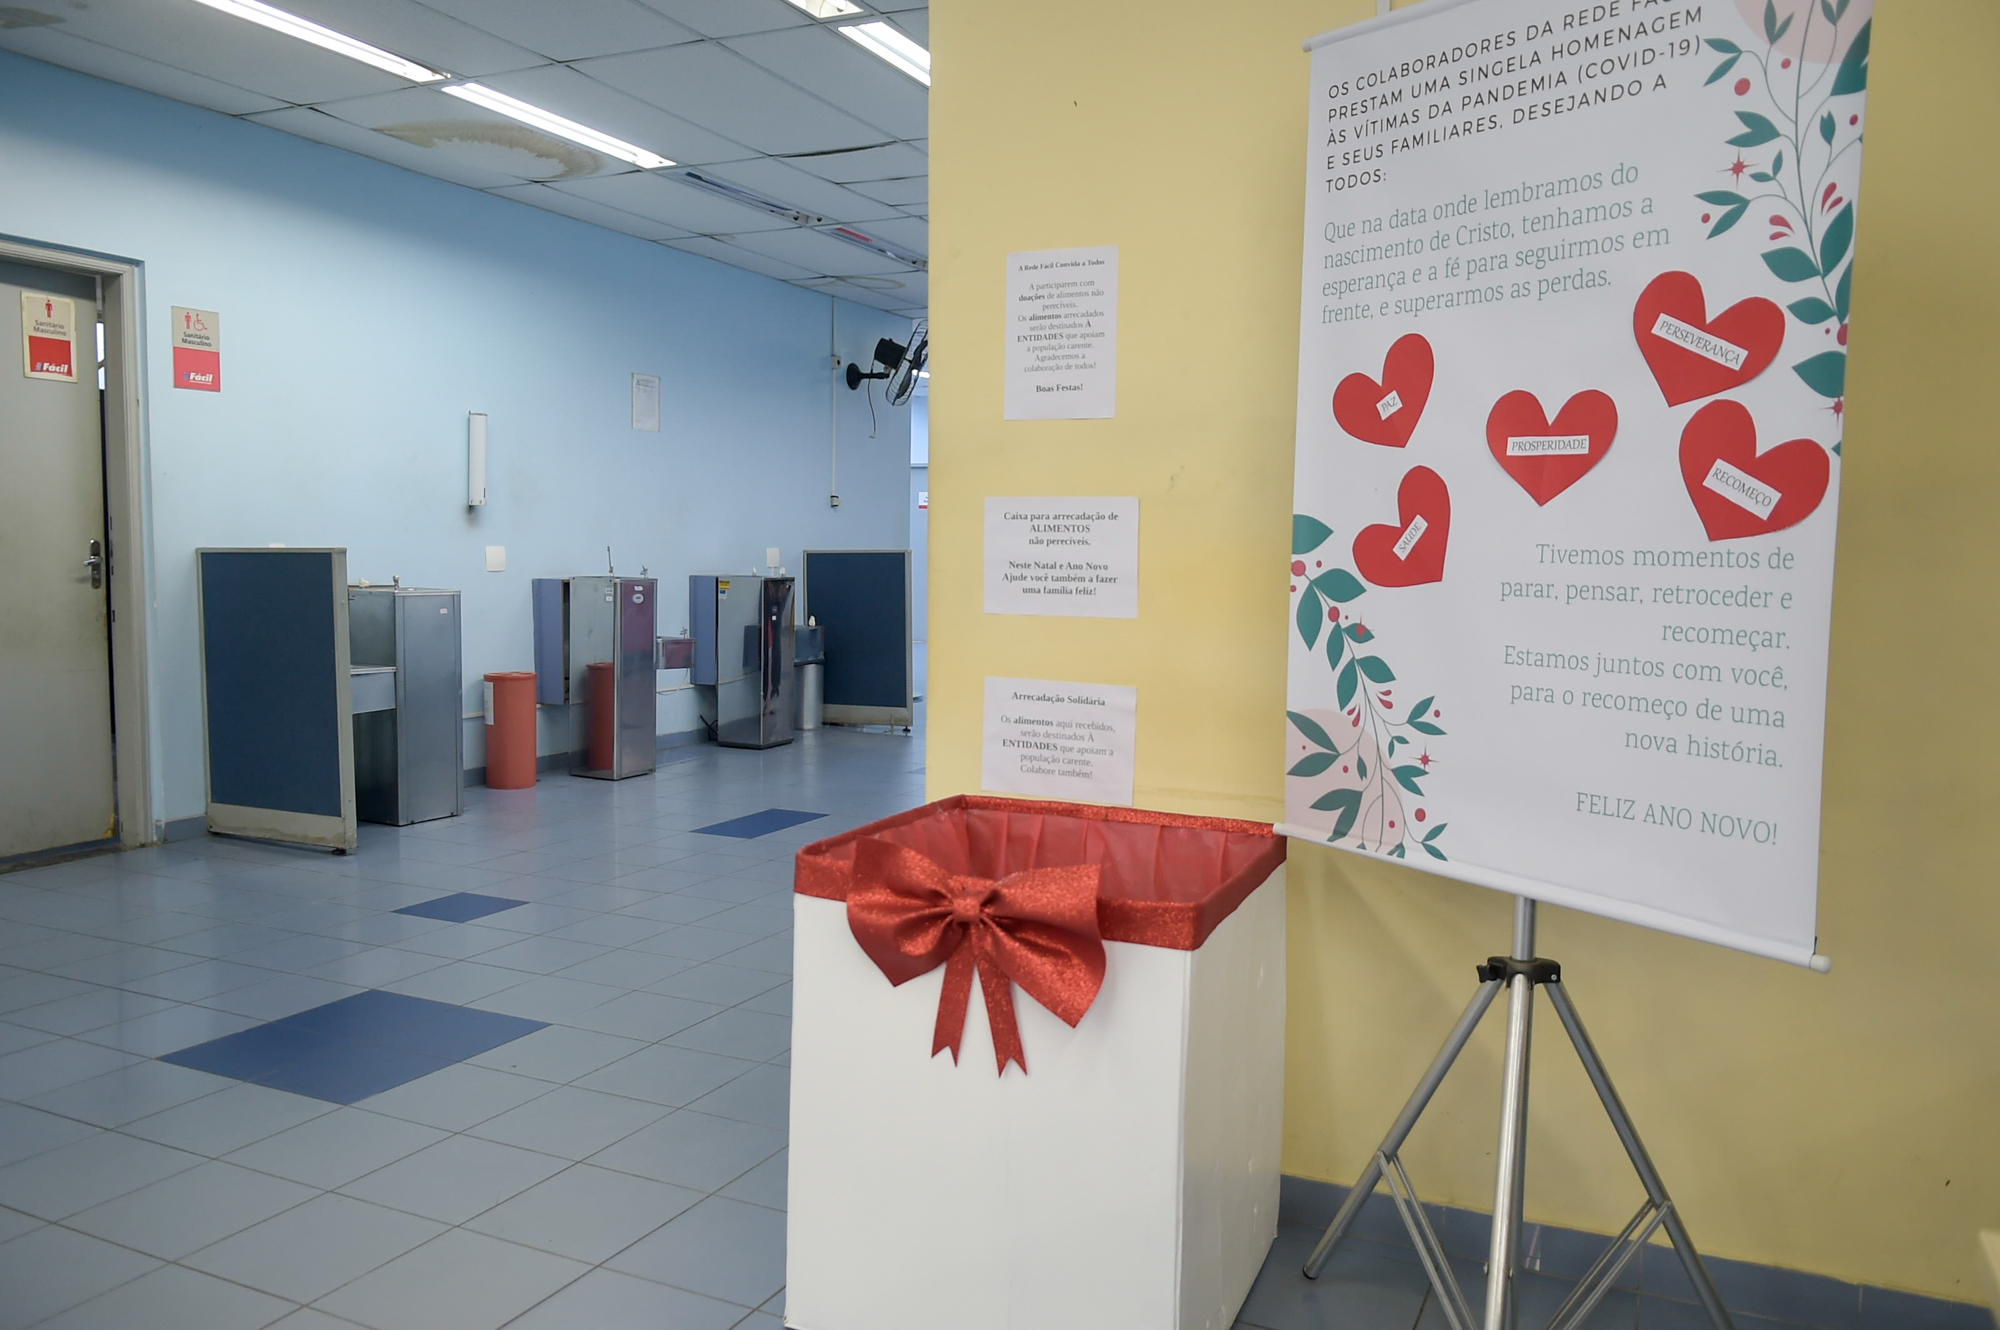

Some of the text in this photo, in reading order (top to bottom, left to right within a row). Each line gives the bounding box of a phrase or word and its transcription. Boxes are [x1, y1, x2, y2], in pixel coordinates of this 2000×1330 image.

[1328, 81, 1349, 99] OS
[1355, 30, 1516, 91] COLABORADORES
[1526, 20, 1554, 42] DA
[1563, 0, 1620, 31] REDE
[1328, 5, 1702, 123] PRESTAM UMA SINGELA HOMENAGEM
[1326, 34, 1701, 147] ÀS VÍTIMAS DA PANDEMIA (COVID-19)
[1327, 73, 1667, 170] E SEUS FAMILIARES, DESEJANDO A
[1325, 168, 1386, 193] TODOS:
[1324, 162, 1639, 244] Que na data onde lembramos do
[1323, 197, 1654, 270] nascimento de Cristo, tenhamos a
[1322, 228, 1670, 300] esperança e a fé para seguirmos em
[1036, 282, 1078, 292] participarem
[1018, 293, 1045, 302] doações
[1322, 267, 1612, 324] frente, e superarmos as perdas.
[1042, 301, 1078, 312] perecíveis.
[1064, 310, 1104, 318] arrecadados
[33, 326, 66, 336] Masculino
[34, 320, 64, 330] Sanitário
[1029, 324, 1047, 332] serão
[1048, 321, 1083, 330] destinados
[182, 338, 212, 347] Masculino
[183, 331, 210, 340] Sanitário
[1017, 333, 1064, 342] ENTIDADES
[1080, 332, 1105, 340] apoiam
[1659, 320, 1740, 365] PERSEVERANÇA
[1032, 343, 1066, 354] população
[1067, 342, 1094, 350] carente.
[1035, 353, 1080, 363] Agradecemos
[1024, 363, 1063, 372] colaboração
[1074, 362, 1096, 370] todos!
[1056, 383, 1083, 392] Festas!
[1381, 396, 1398, 412] PAZ
[1512, 438, 1587, 452] PROSPERIDADE
[1712, 467, 1772, 507] RECOMEÇO
[1004, 512, 1118, 522] Caixa para arrecadação de
[1030, 524, 1090, 532] ALIMENTOS
[1029, 536, 1090, 547] não perecíveis.
[1398, 522, 1422, 553] SAÚDE
[1535, 543, 1795, 570] Tivemos momentos de
[1009, 561, 1032, 569] Neste
[1034, 561, 1056, 570] Natal
[1066, 562, 1083, 570] Ano
[1086, 562, 1108, 570] Novo
[1002, 573, 1028, 583] Ajude
[1030, 573, 1048, 582] você
[1051, 574, 1086, 582] também
[1096, 574, 1118, 583] fazer
[1044, 586, 1073, 594] família
[1075, 586, 1096, 595] feliz!
[1500, 581, 1793, 610] parar, pensar, retroceder e
[1661, 625, 1790, 653] recomeçar.
[1503, 644, 1788, 691] Estamos juntos com você,
[1012, 692, 1105, 706] Arrecadação Solidária
[1510, 684, 1785, 729] para o recomeço de uma
[1001, 715, 1115, 732] Os alimentos aqui recebidos,
[1020, 729, 1041, 738] serão
[1042, 730, 1085, 741] destinados
[1002, 738, 1058, 751] ENTIDADES
[1060, 745, 1074, 754] que
[1624, 731, 1783, 768] nova história.
[1020, 754, 1093, 766] população carente.
[1020, 764, 1092, 779] Colabore também!
[1576, 791, 1777, 846] FELIZ ANO NOVO!
